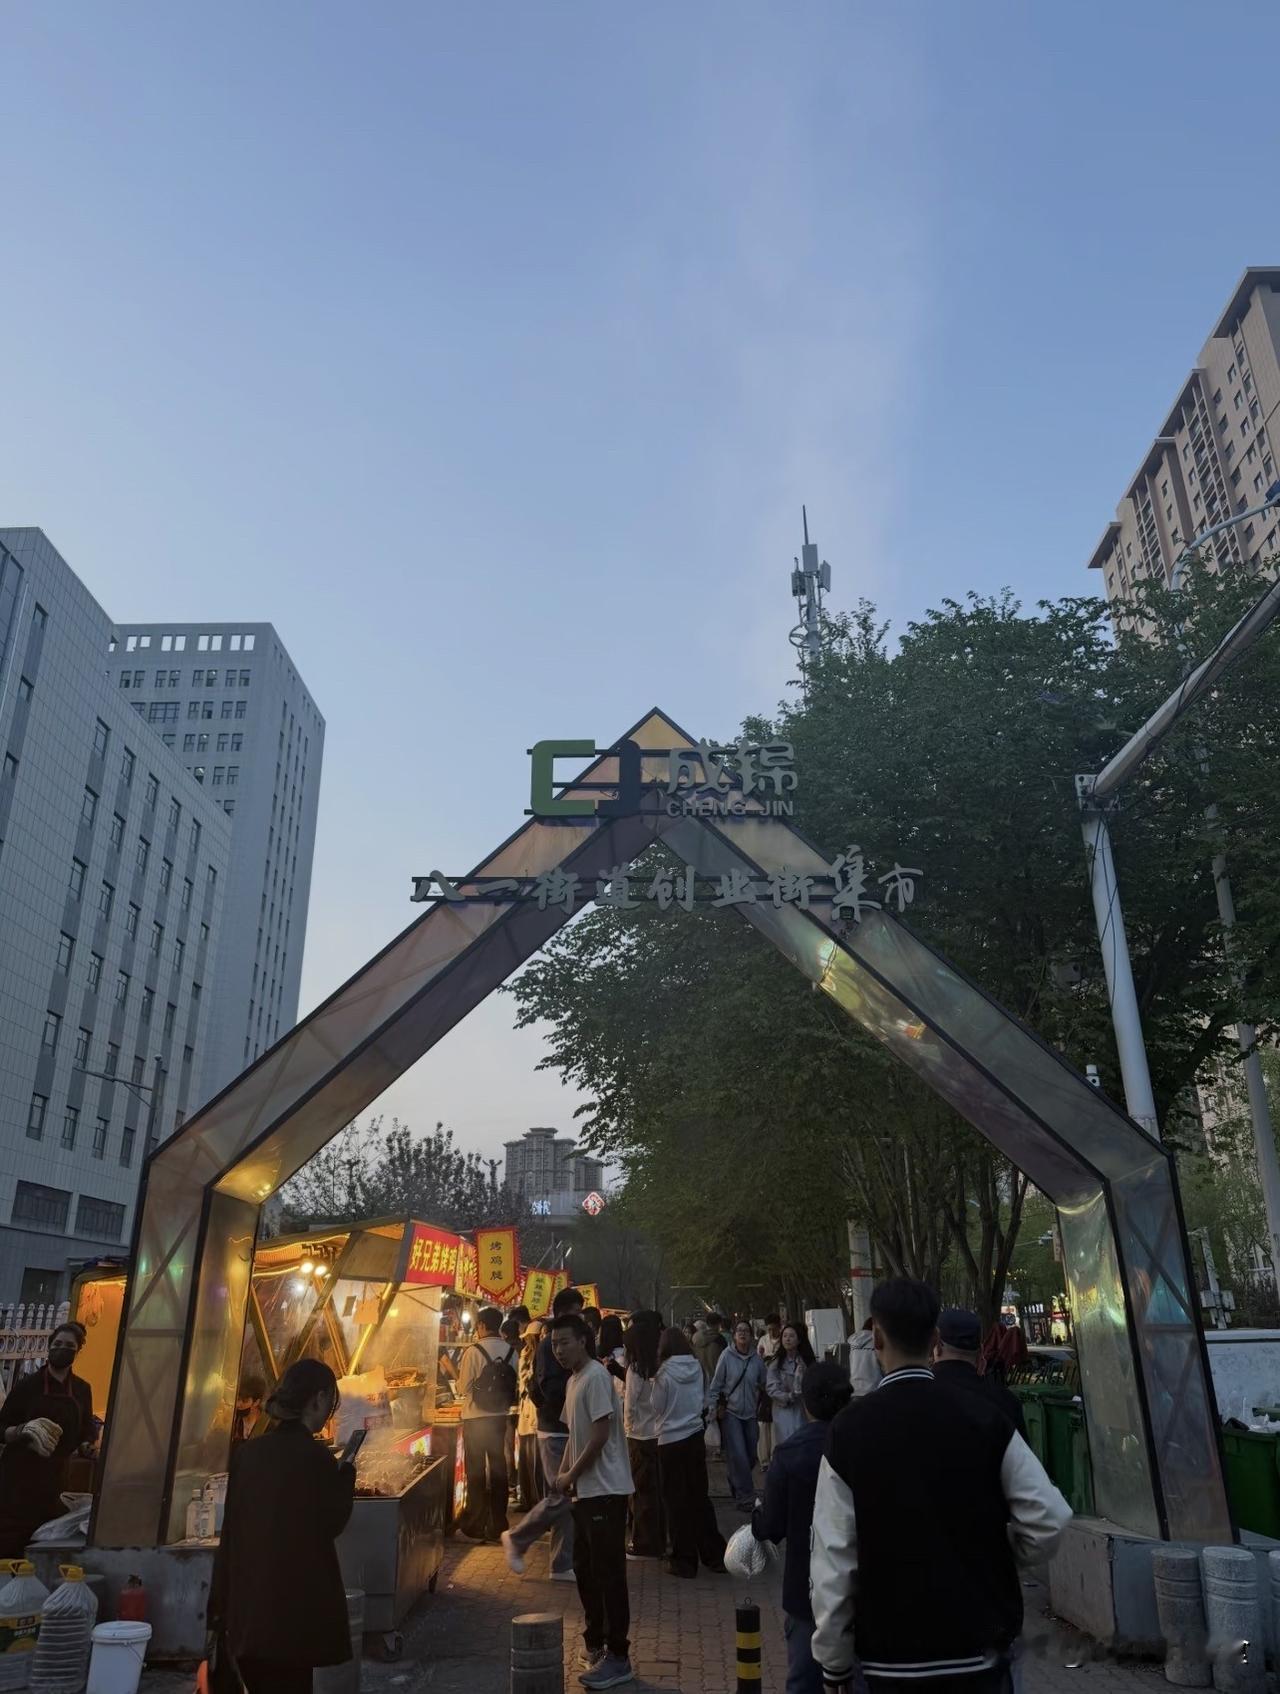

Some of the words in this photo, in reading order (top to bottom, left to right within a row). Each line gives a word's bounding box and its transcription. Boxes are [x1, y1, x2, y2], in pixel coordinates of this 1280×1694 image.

[667, 738, 798, 795] 成锦
[666, 800, 746, 817] CHENG
[759, 800, 794, 816] JIN
[409, 845, 924, 920] 八一街道创业街集市
